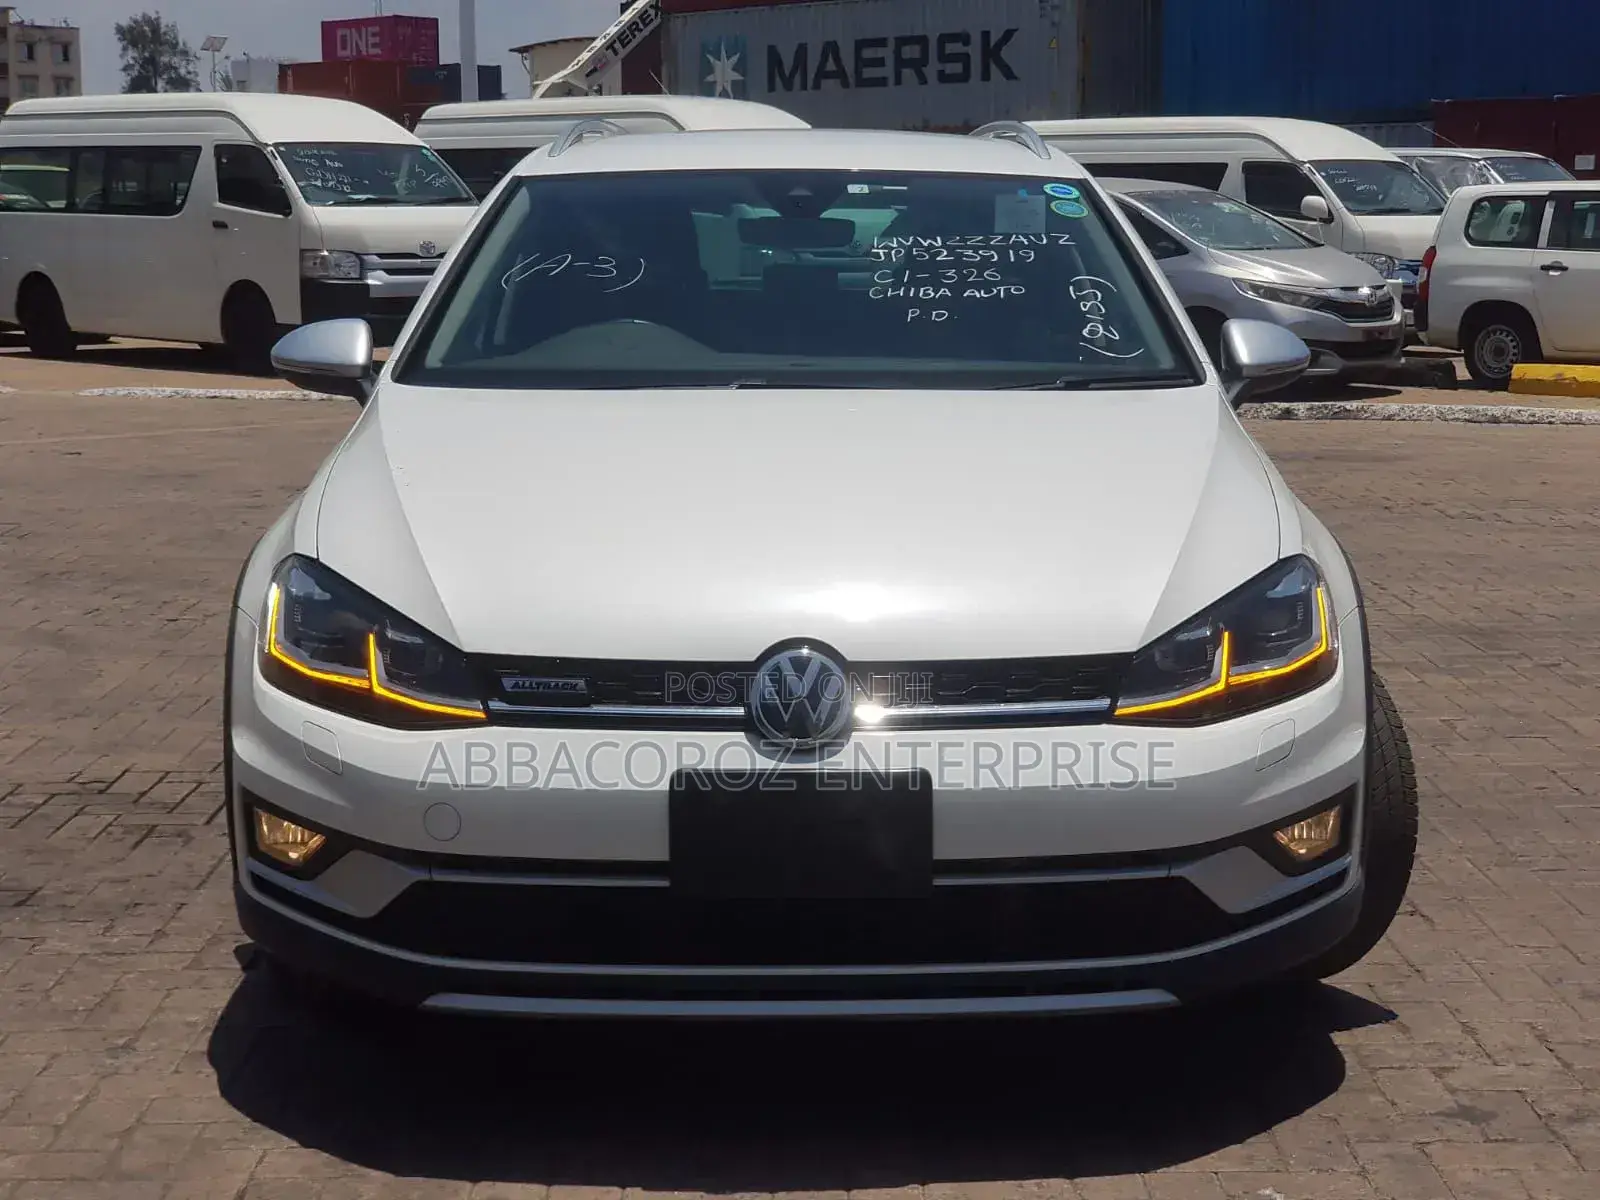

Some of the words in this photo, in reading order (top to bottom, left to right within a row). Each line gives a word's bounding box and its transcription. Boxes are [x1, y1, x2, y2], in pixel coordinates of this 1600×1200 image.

[336, 26, 382, 58] ONE
[605, 0, 661, 56] TEREX
[766, 28, 1021, 94] MAERSK
[868, 286, 952, 299] CHIBA
[962, 285, 1025, 299] AUTO
[510, 680, 580, 691] ALLTRACK
